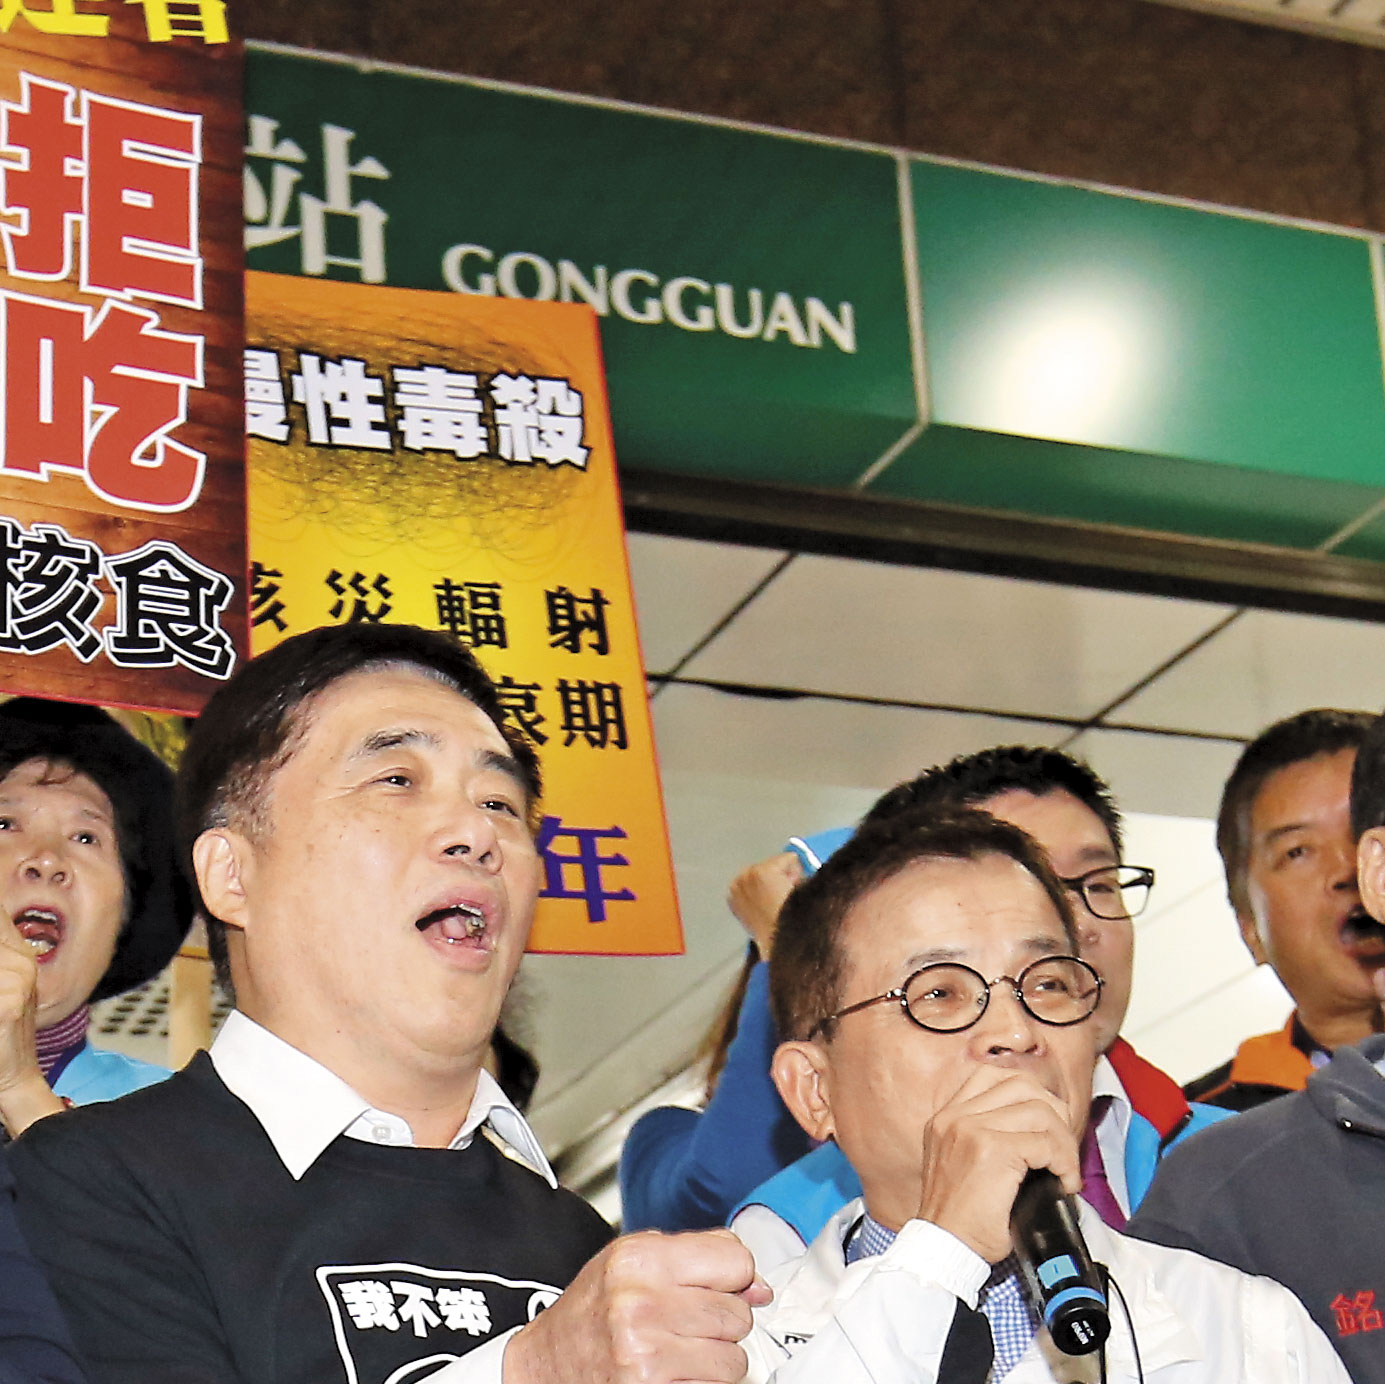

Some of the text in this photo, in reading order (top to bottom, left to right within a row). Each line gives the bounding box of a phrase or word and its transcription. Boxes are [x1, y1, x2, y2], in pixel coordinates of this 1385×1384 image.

[244, 113, 393, 285] 站
[442, 243, 858, 354] GONGGUAN
[536, 815, 637, 923] 年
[337, 1279, 493, 1337] 我不笨
